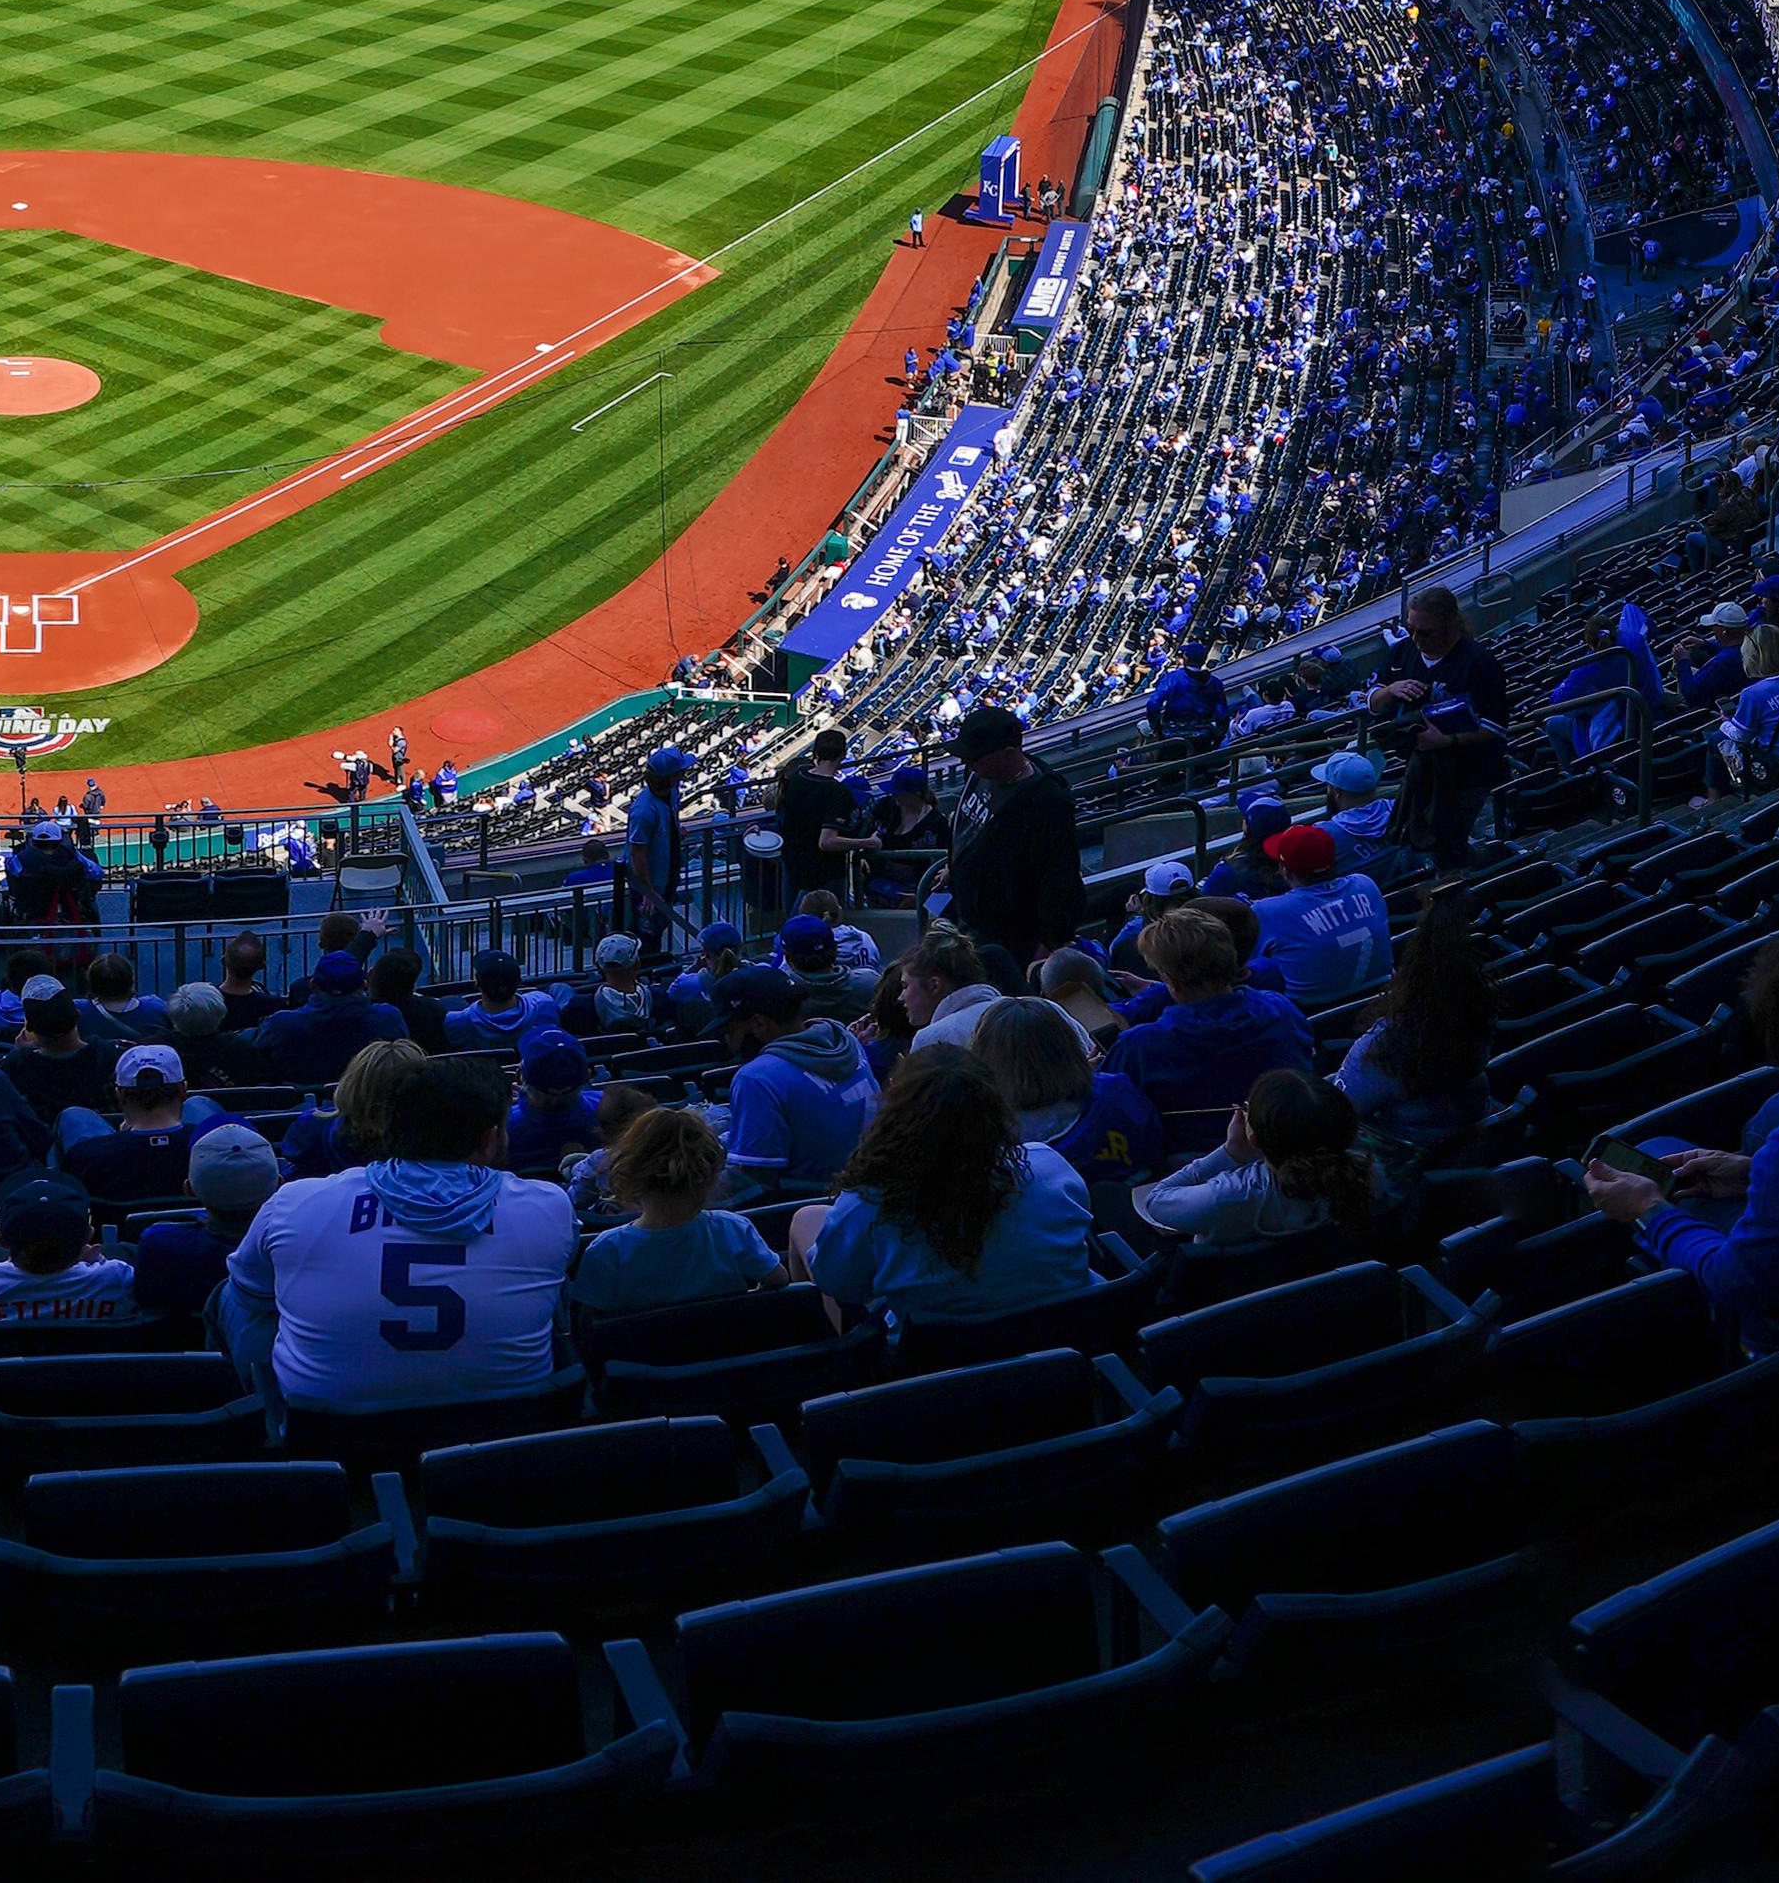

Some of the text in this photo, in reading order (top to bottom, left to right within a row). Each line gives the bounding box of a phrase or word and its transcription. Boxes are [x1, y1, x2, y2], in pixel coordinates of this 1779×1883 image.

[982, 179, 998, 198] KC
[1049, 229, 1076, 277] DUGOUT SUITES
[1024, 276, 1062, 317] UMB
[866, 502, 944, 588] HOME OF THE
[57, 717, 112, 734] DAY
[1300, 895, 1350, 935] WITT
[1334, 926, 1374, 984] 7
[379, 1242, 466, 1352] 5
